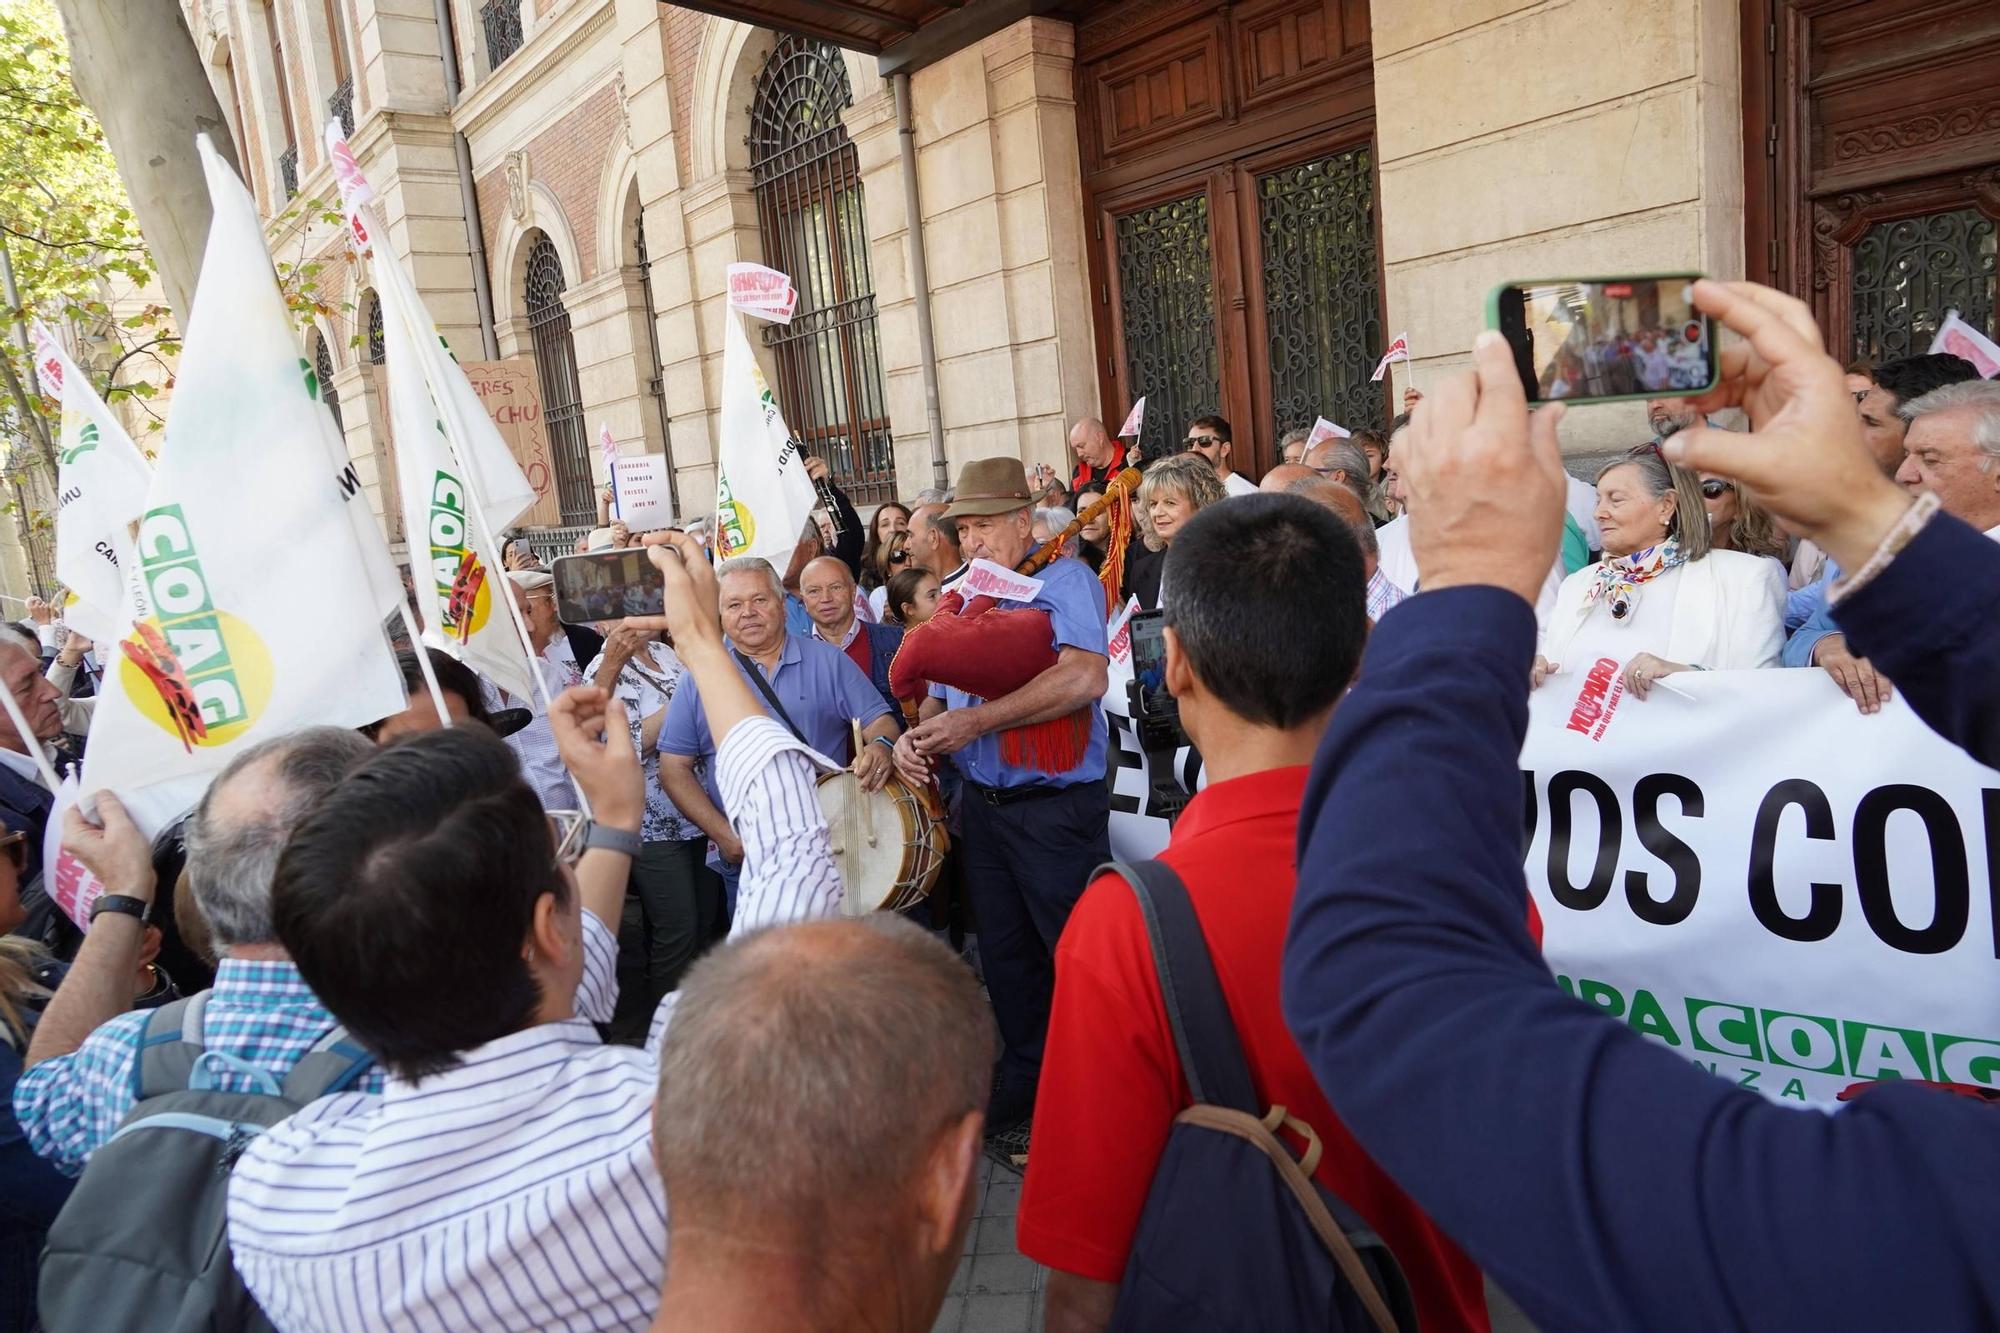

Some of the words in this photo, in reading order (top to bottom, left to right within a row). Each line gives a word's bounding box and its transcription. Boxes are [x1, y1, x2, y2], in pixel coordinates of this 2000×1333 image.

[139, 507, 244, 727] COAG
[1592, 722, 1608, 742] PARA
[1602, 710, 1614, 724] QUE
[1608, 695, 1622, 712] PARE
